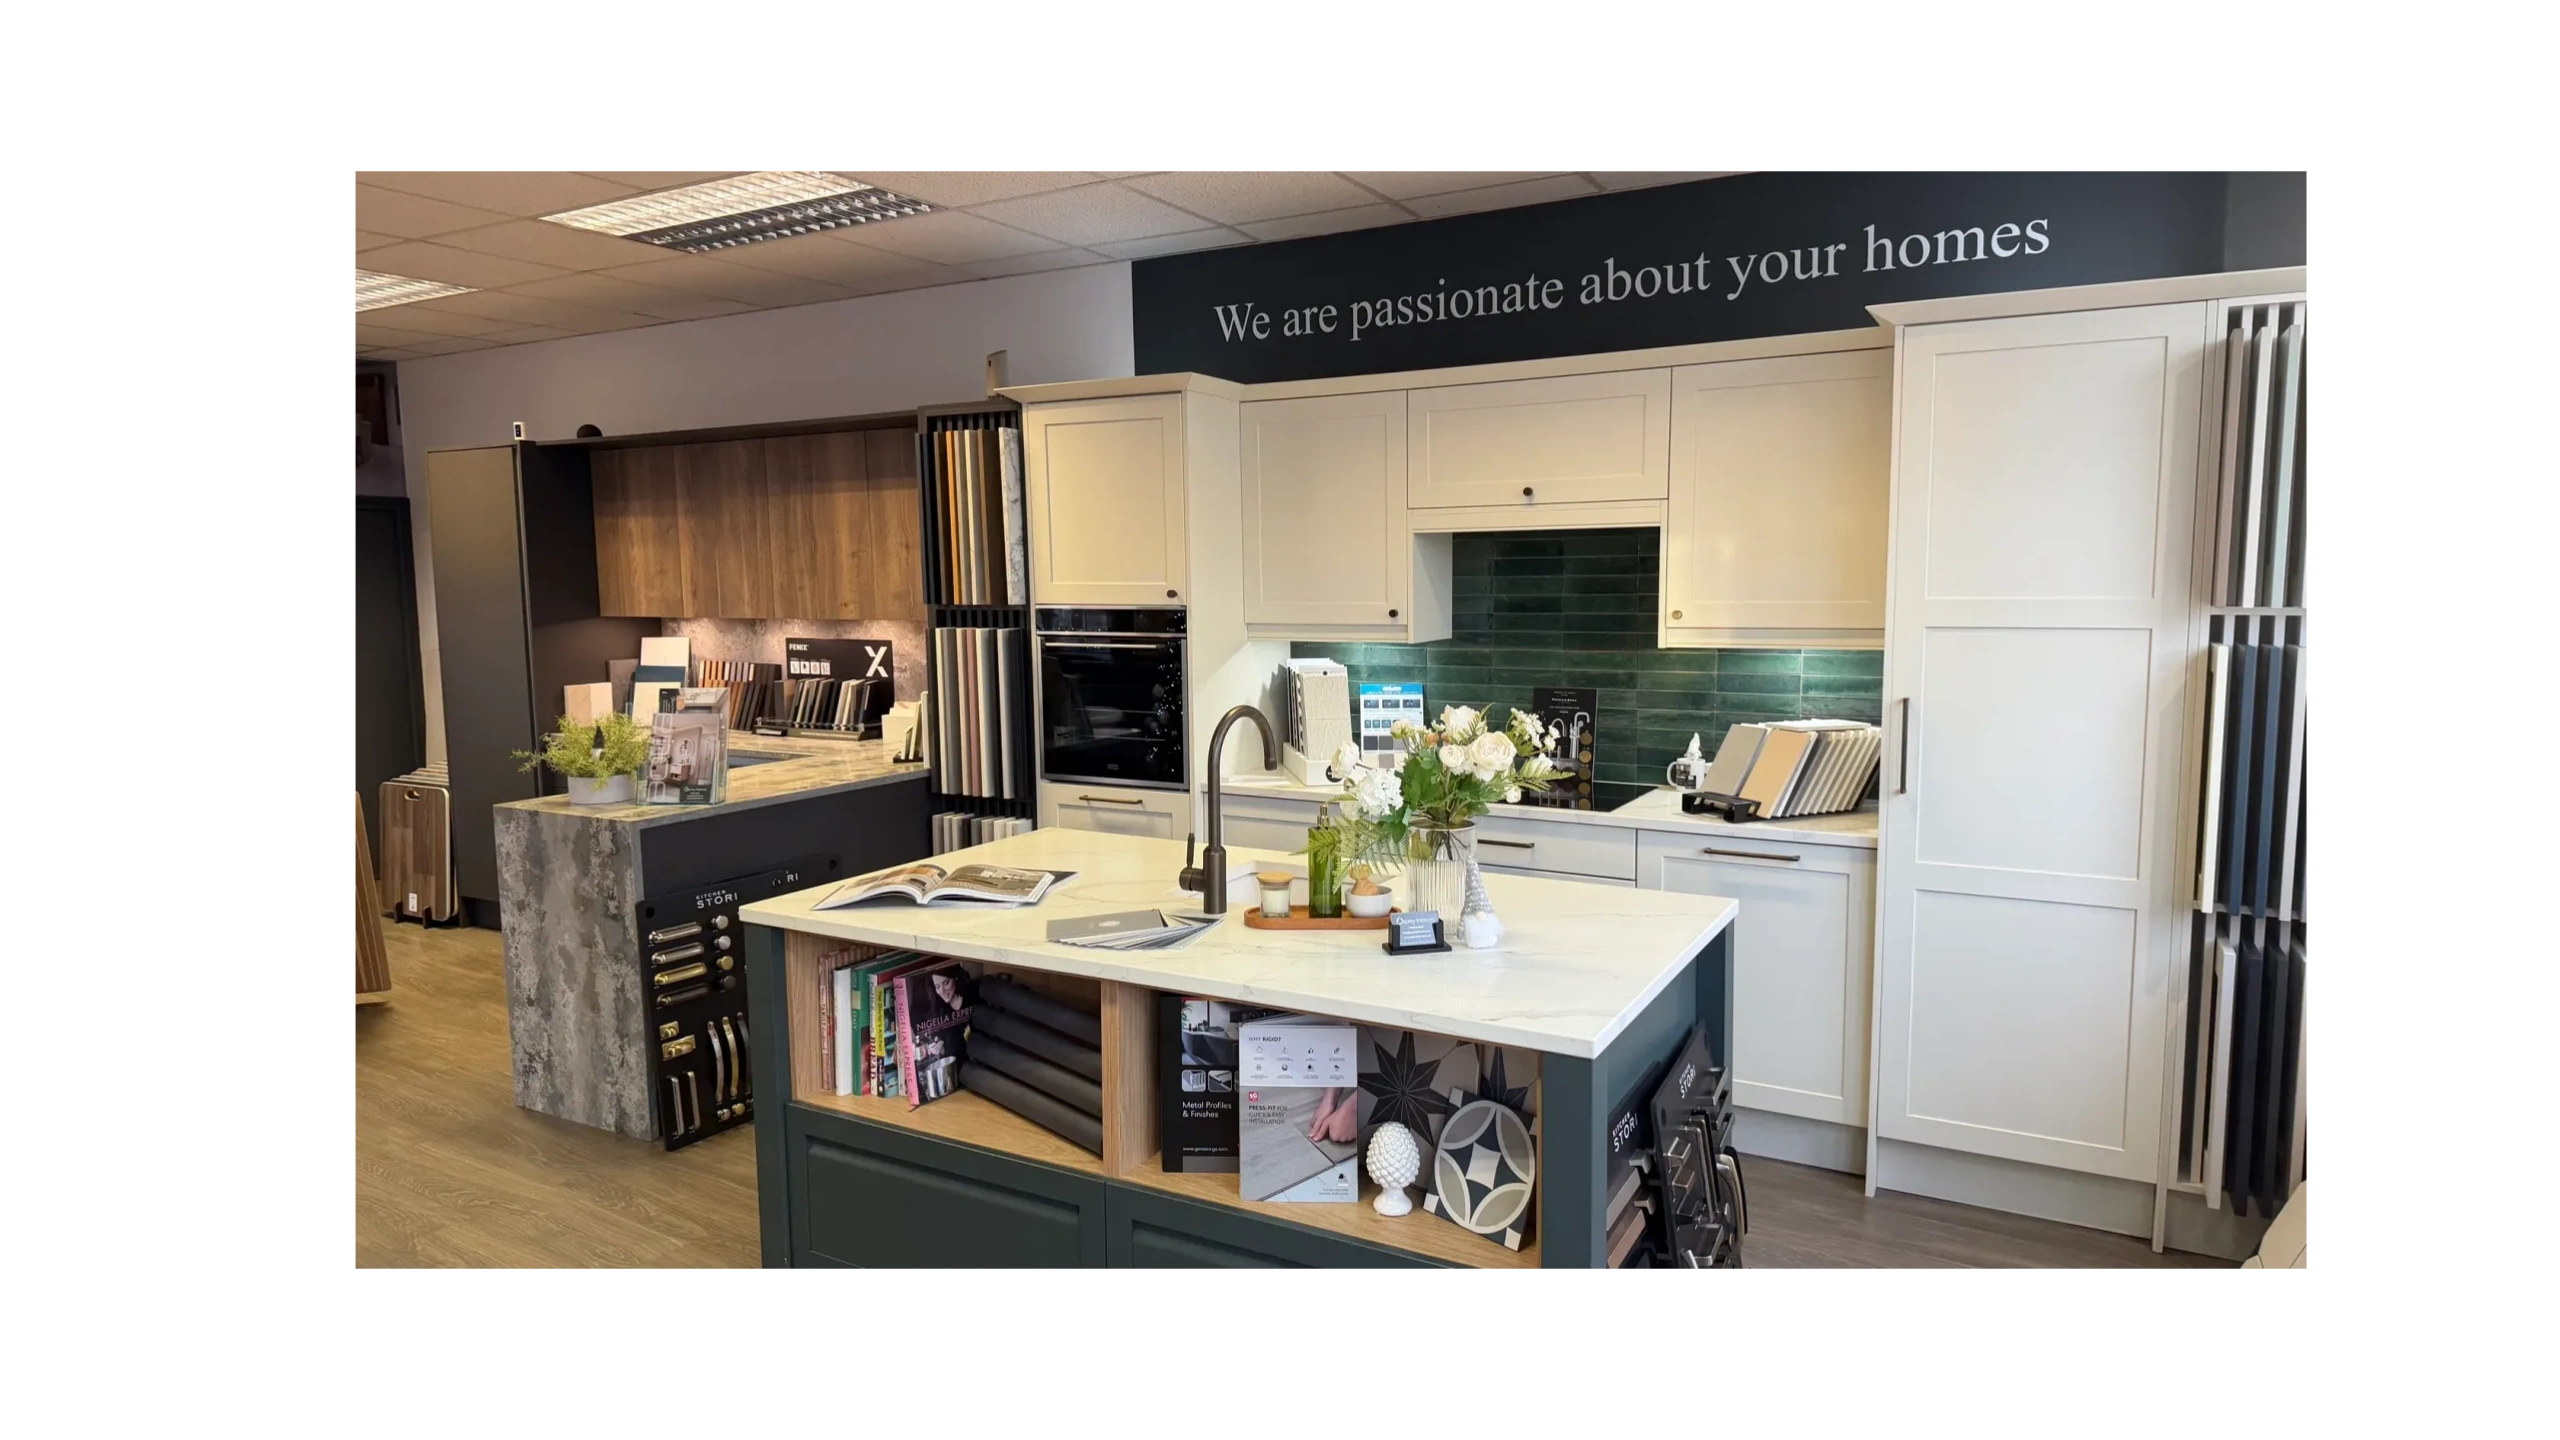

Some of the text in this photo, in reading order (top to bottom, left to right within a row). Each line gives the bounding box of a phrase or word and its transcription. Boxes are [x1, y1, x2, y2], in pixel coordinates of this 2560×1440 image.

[1213, 217, 2051, 342] We are passionate about your homes
[789, 643, 808, 651] FENIX
[696, 890, 726, 900] KITCHEN
[697, 892, 738, 909] STORI
[897, 1003, 909, 1042] NIGELLA
[916, 1014, 950, 1032] NIGELLA
[952, 1006, 975, 1020] EXPRE
[902, 1045, 913, 1084] EXPRESS
[1680, 1064, 1696, 1099] STORI
[1182, 1101, 1231, 1109] Metal Profiles
[1612, 1111, 1630, 1138] KITCHEN
[1613, 1113, 1638, 1152] STORI
